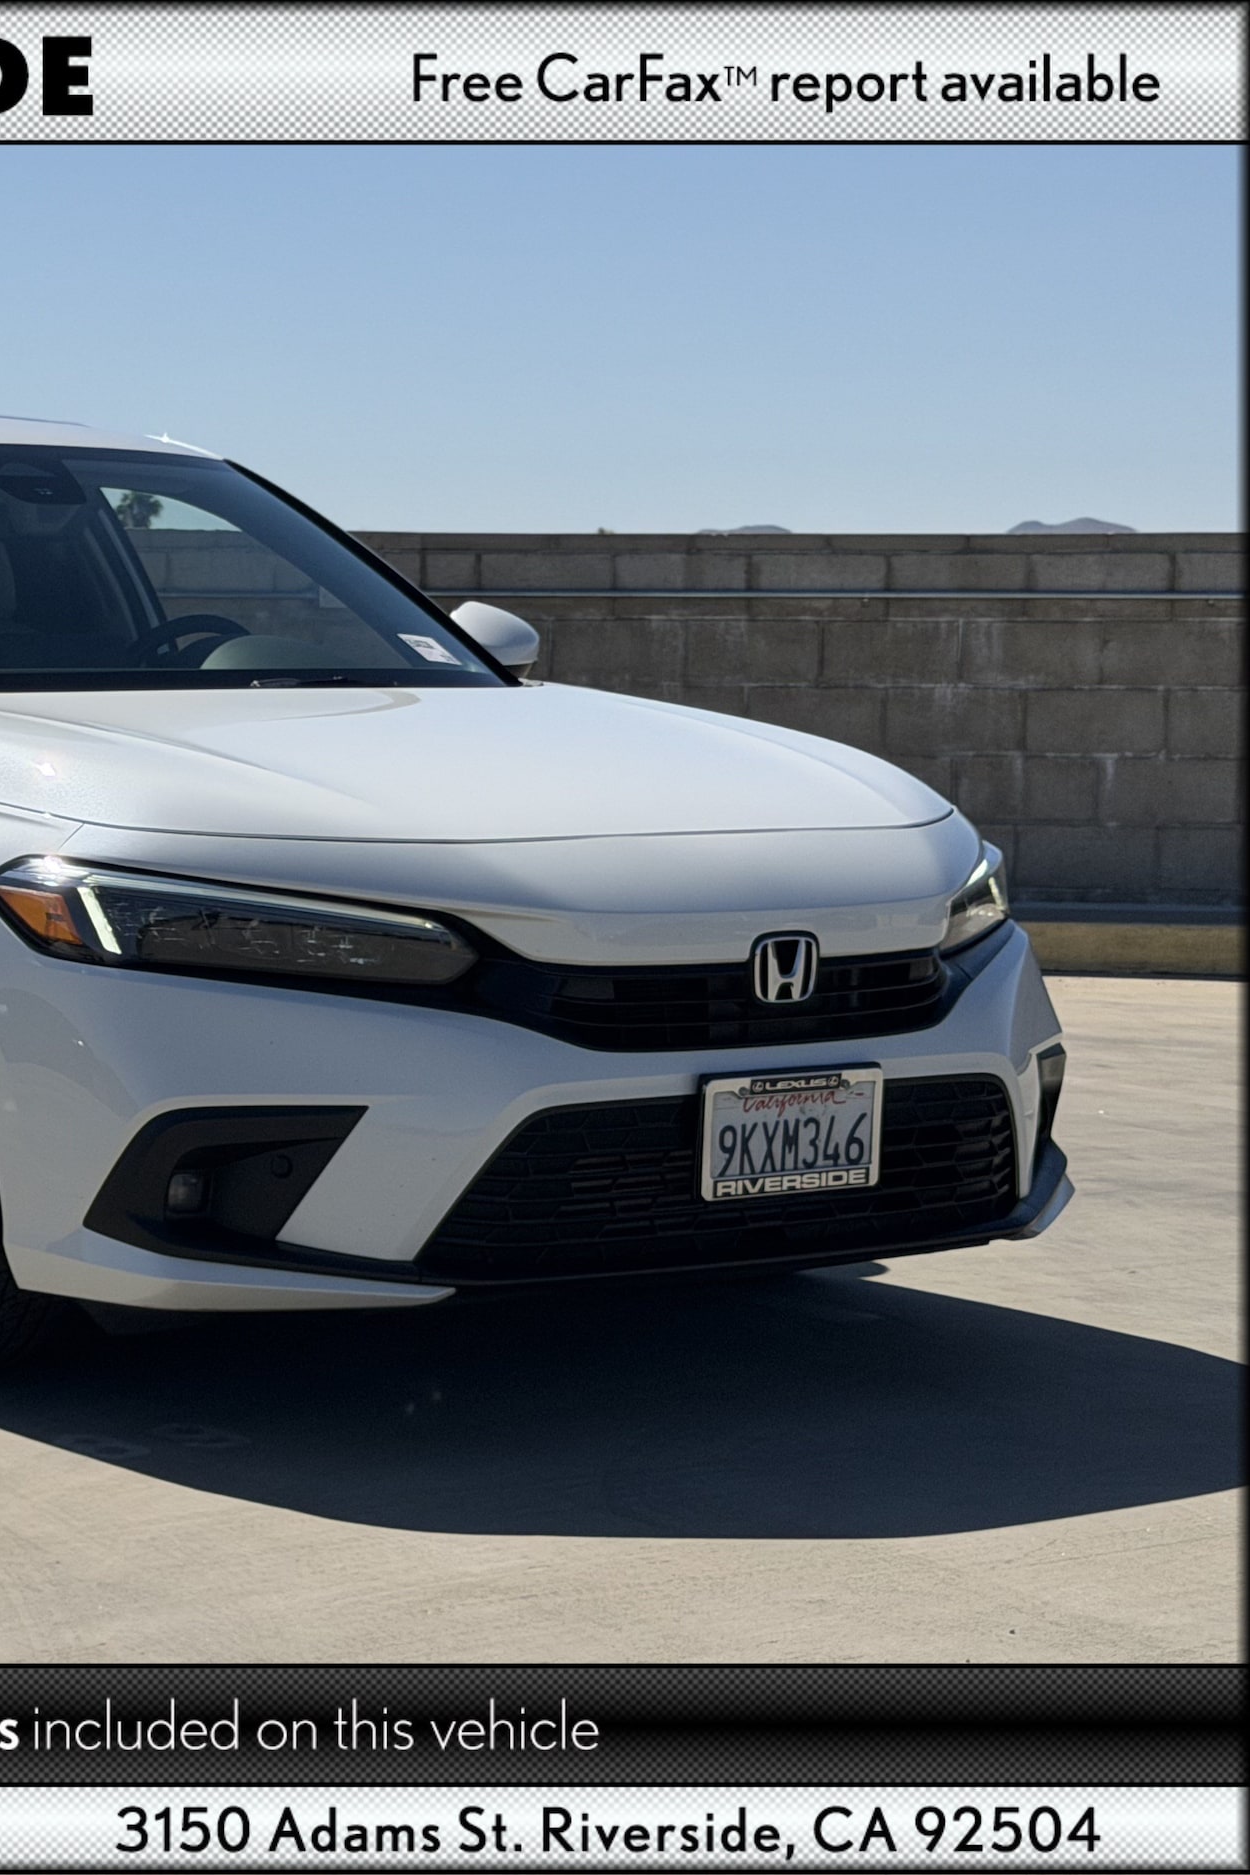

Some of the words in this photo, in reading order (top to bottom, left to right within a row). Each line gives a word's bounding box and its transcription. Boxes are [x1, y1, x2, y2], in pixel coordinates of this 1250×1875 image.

[765, 1077, 828, 1090] LEXUS
[743, 1090, 846, 1118] California
[718, 1112, 868, 1178] 9KXM346
[716, 1169, 867, 1197] RIVERSIDE
